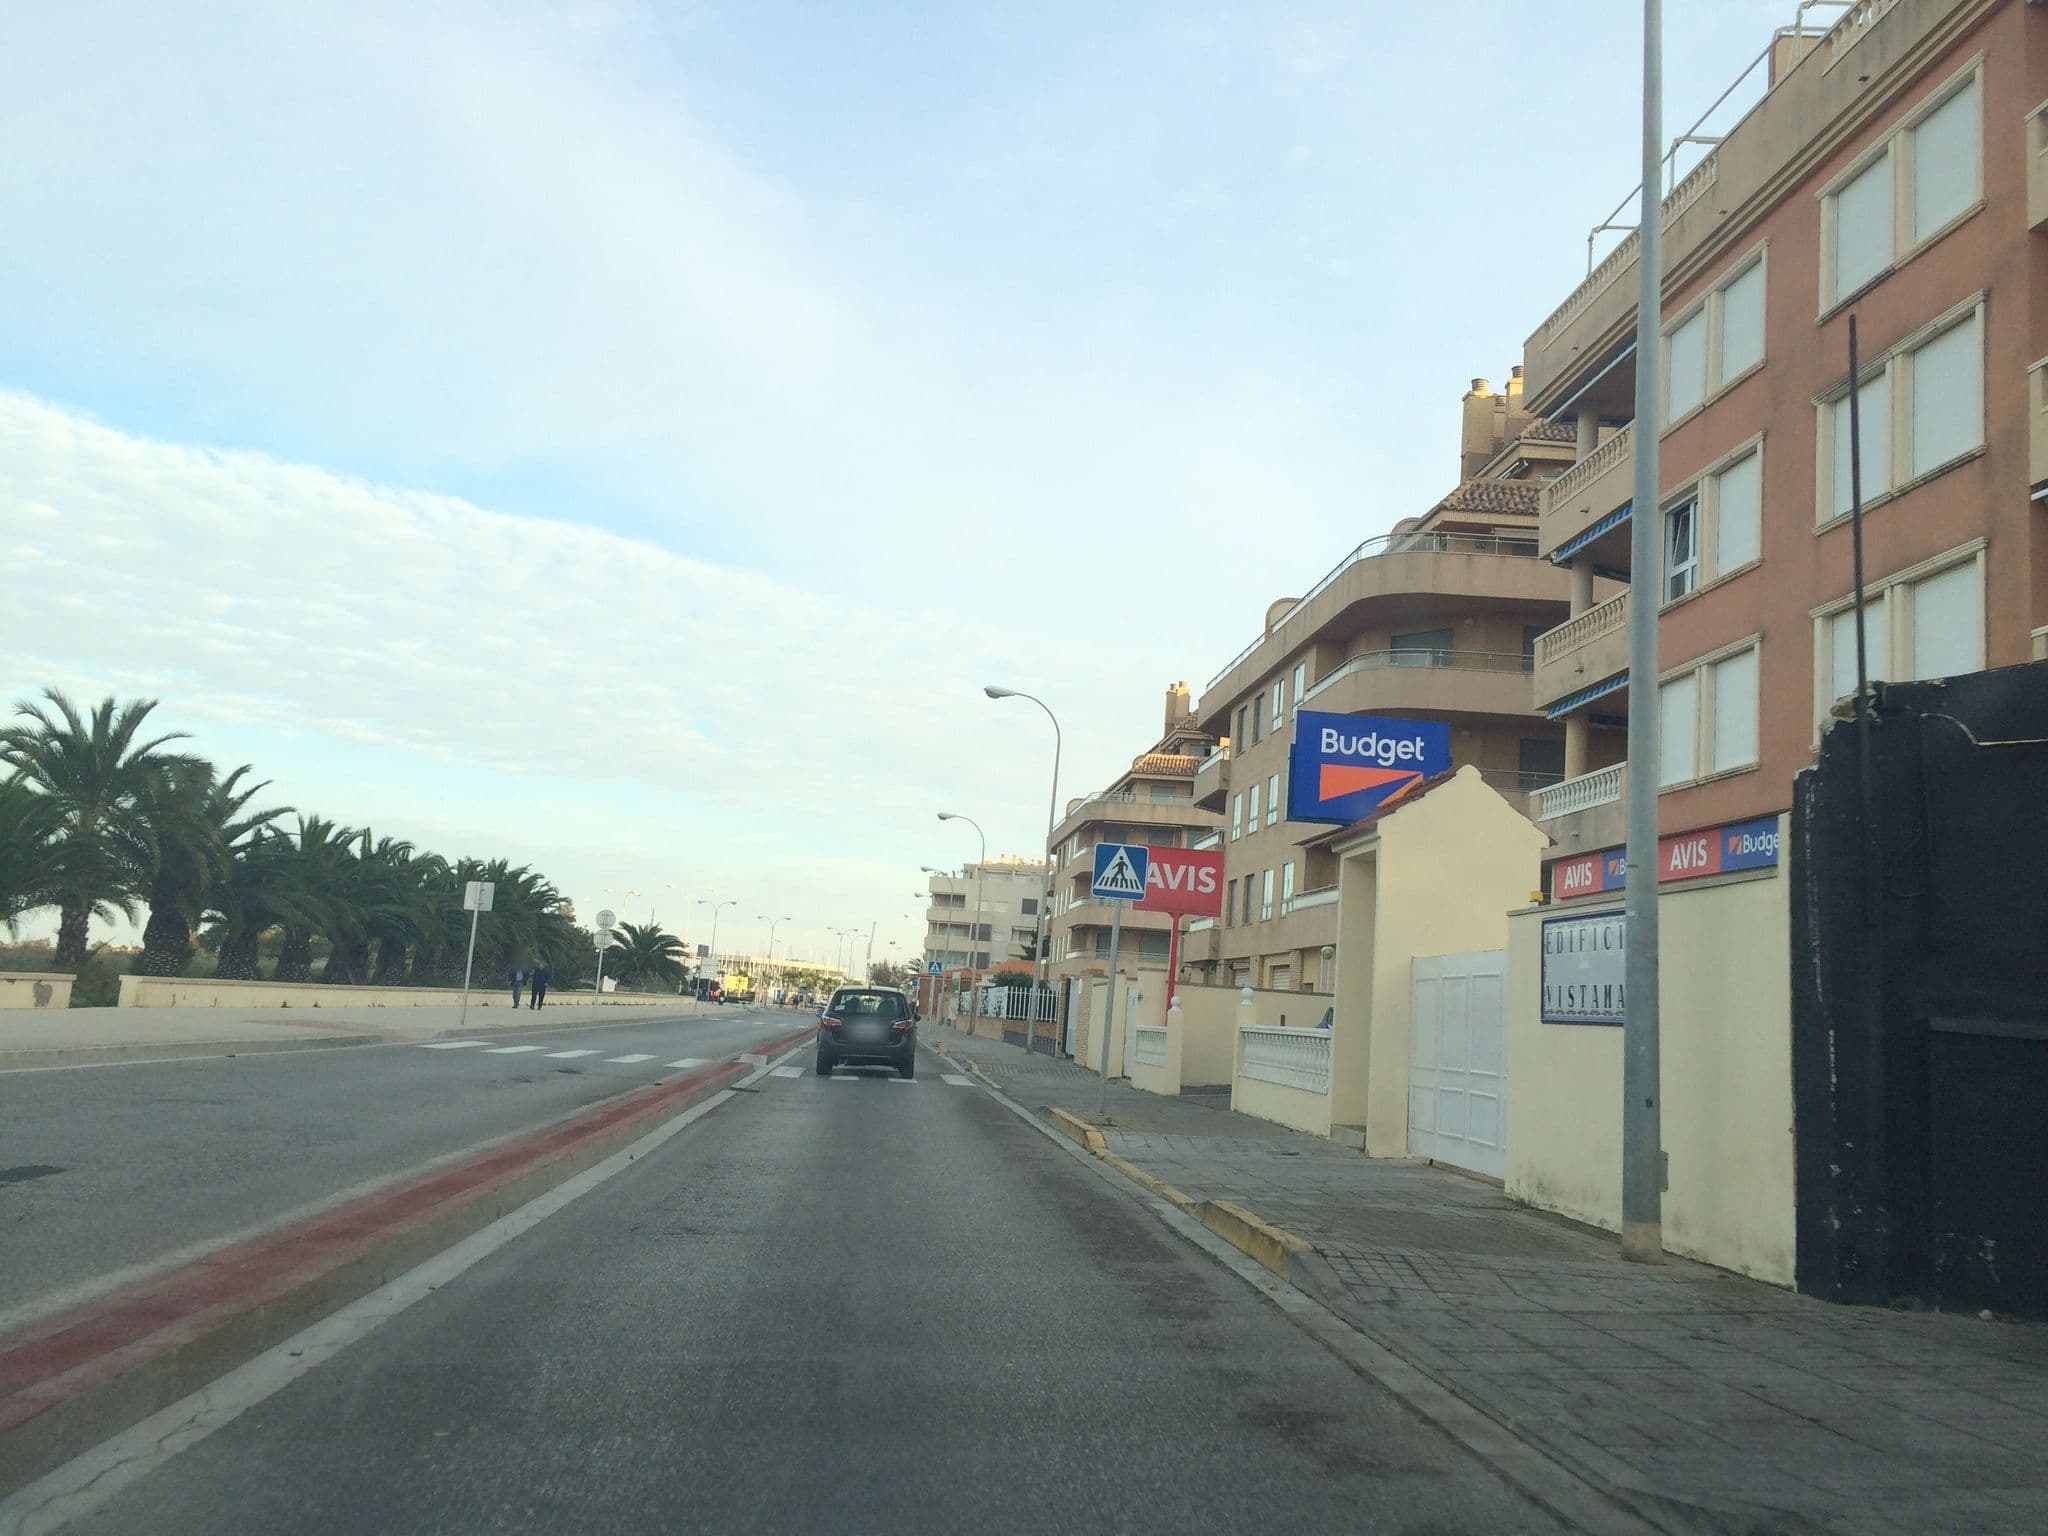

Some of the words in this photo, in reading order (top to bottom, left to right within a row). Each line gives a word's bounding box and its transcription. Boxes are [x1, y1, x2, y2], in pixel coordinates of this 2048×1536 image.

[1321, 728, 1424, 767] Budget
[1670, 838, 1708, 872] AVIS
[1743, 831, 1779, 857] Budge
[1147, 862, 1216, 893] AVIS
[1564, 861, 1593, 890] AVIS
[1546, 925, 1624, 955] EDIFICI
[1546, 984, 1625, 1008] VISTAMA
